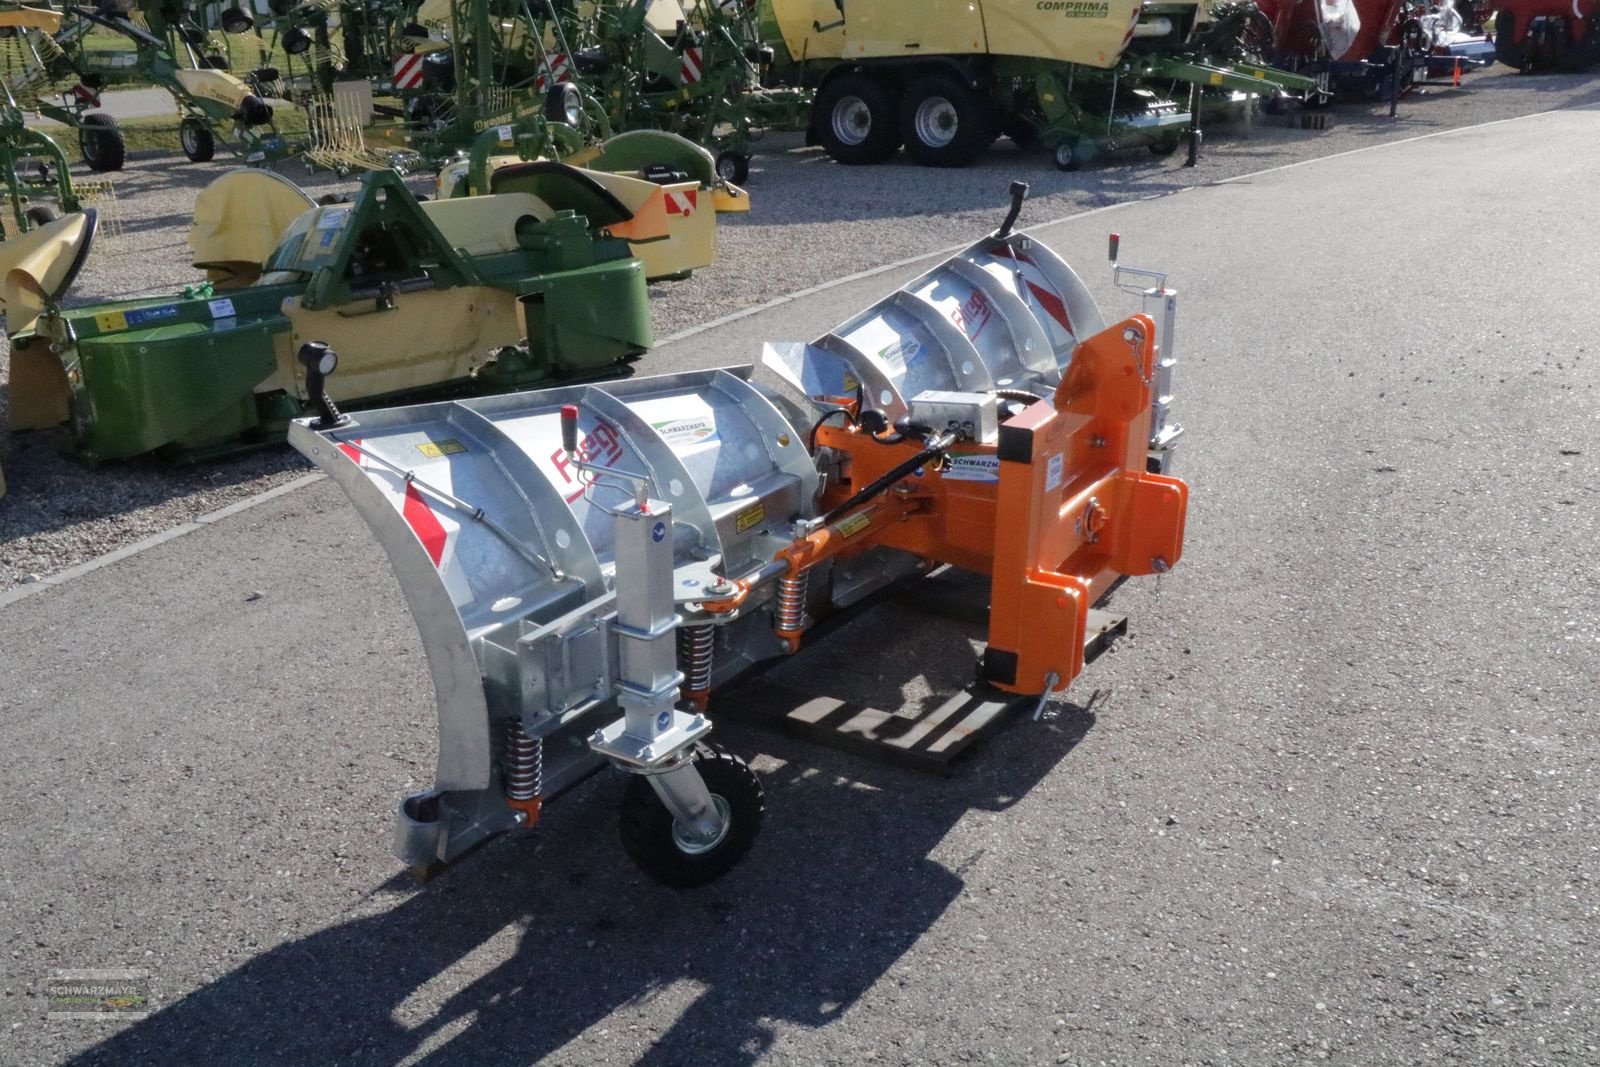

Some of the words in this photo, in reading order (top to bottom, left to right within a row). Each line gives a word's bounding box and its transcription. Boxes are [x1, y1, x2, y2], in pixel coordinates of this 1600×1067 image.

[1036, 1, 1108, 11] COMPRIMA
[659, 422, 706, 435] SCHWARZMAYR
[952, 458, 999, 468] SCHWARZM
